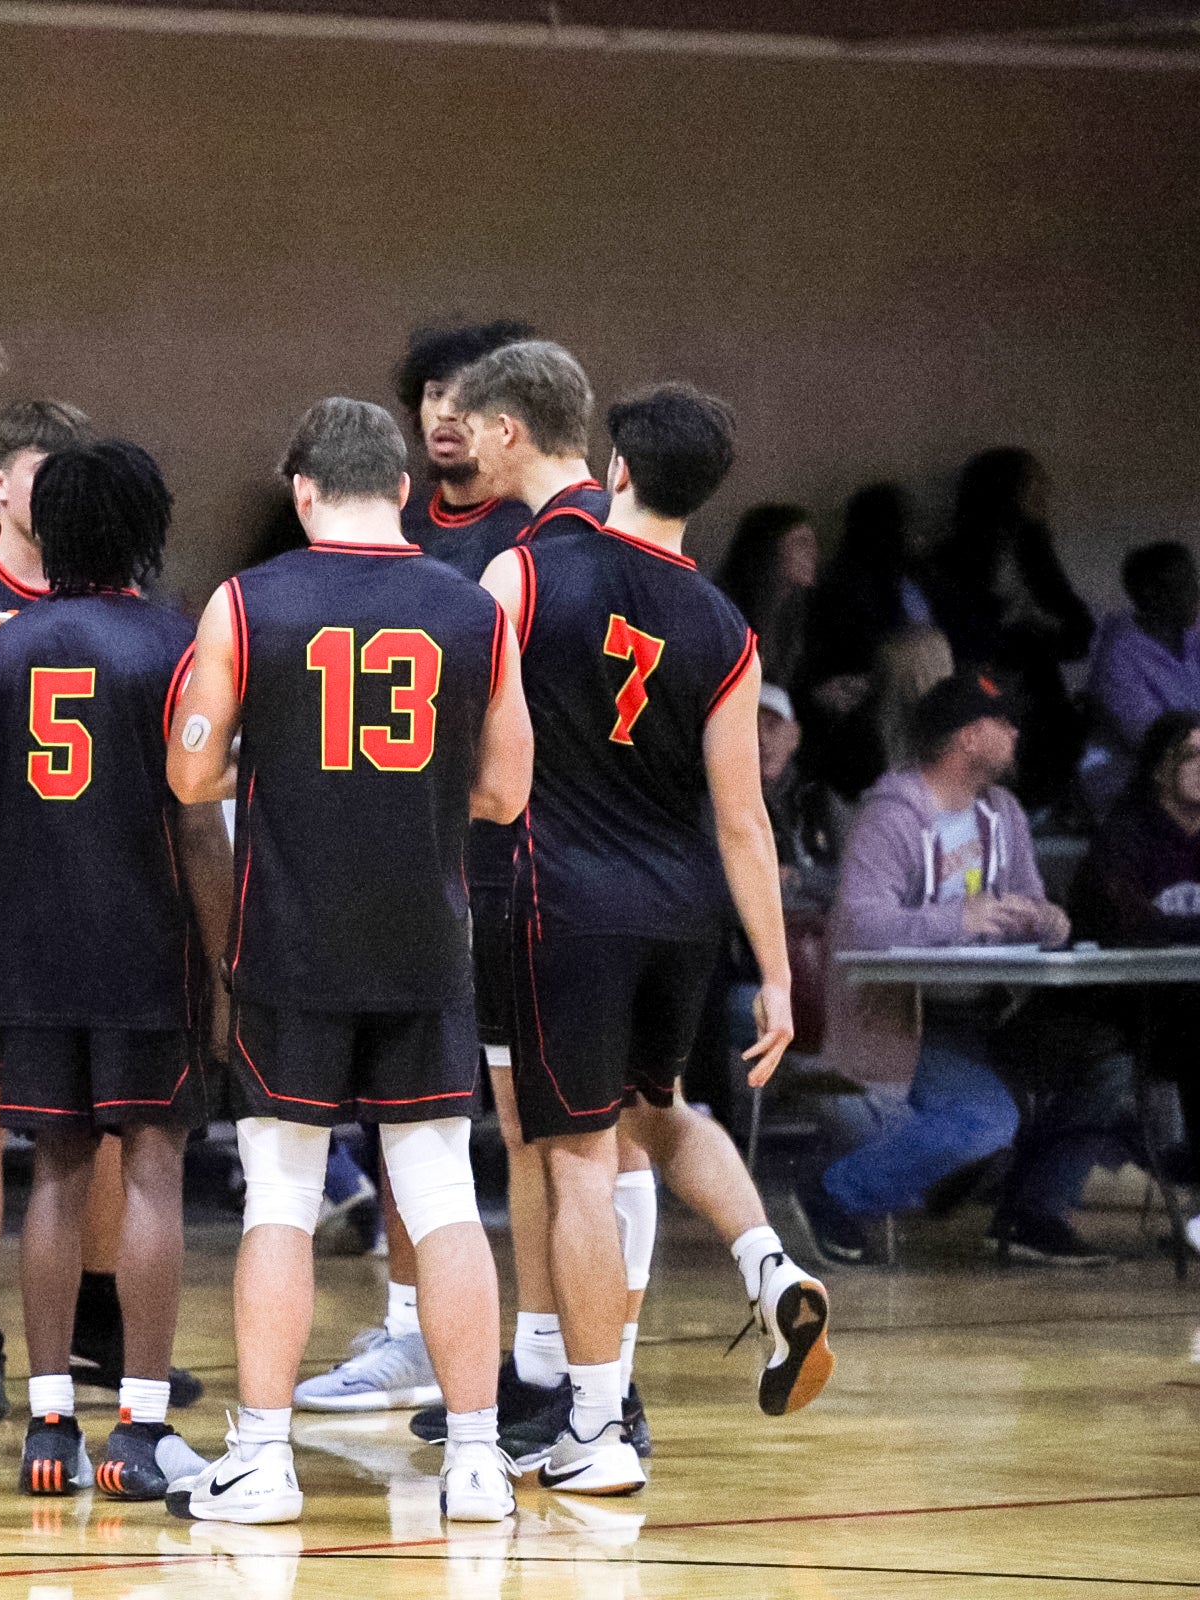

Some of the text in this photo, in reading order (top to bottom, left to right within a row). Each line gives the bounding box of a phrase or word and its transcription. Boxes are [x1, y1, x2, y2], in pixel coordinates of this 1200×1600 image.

[28, 667, 97, 800] 5
[306, 627, 443, 772] 13
[603, 614, 666, 745] 7
